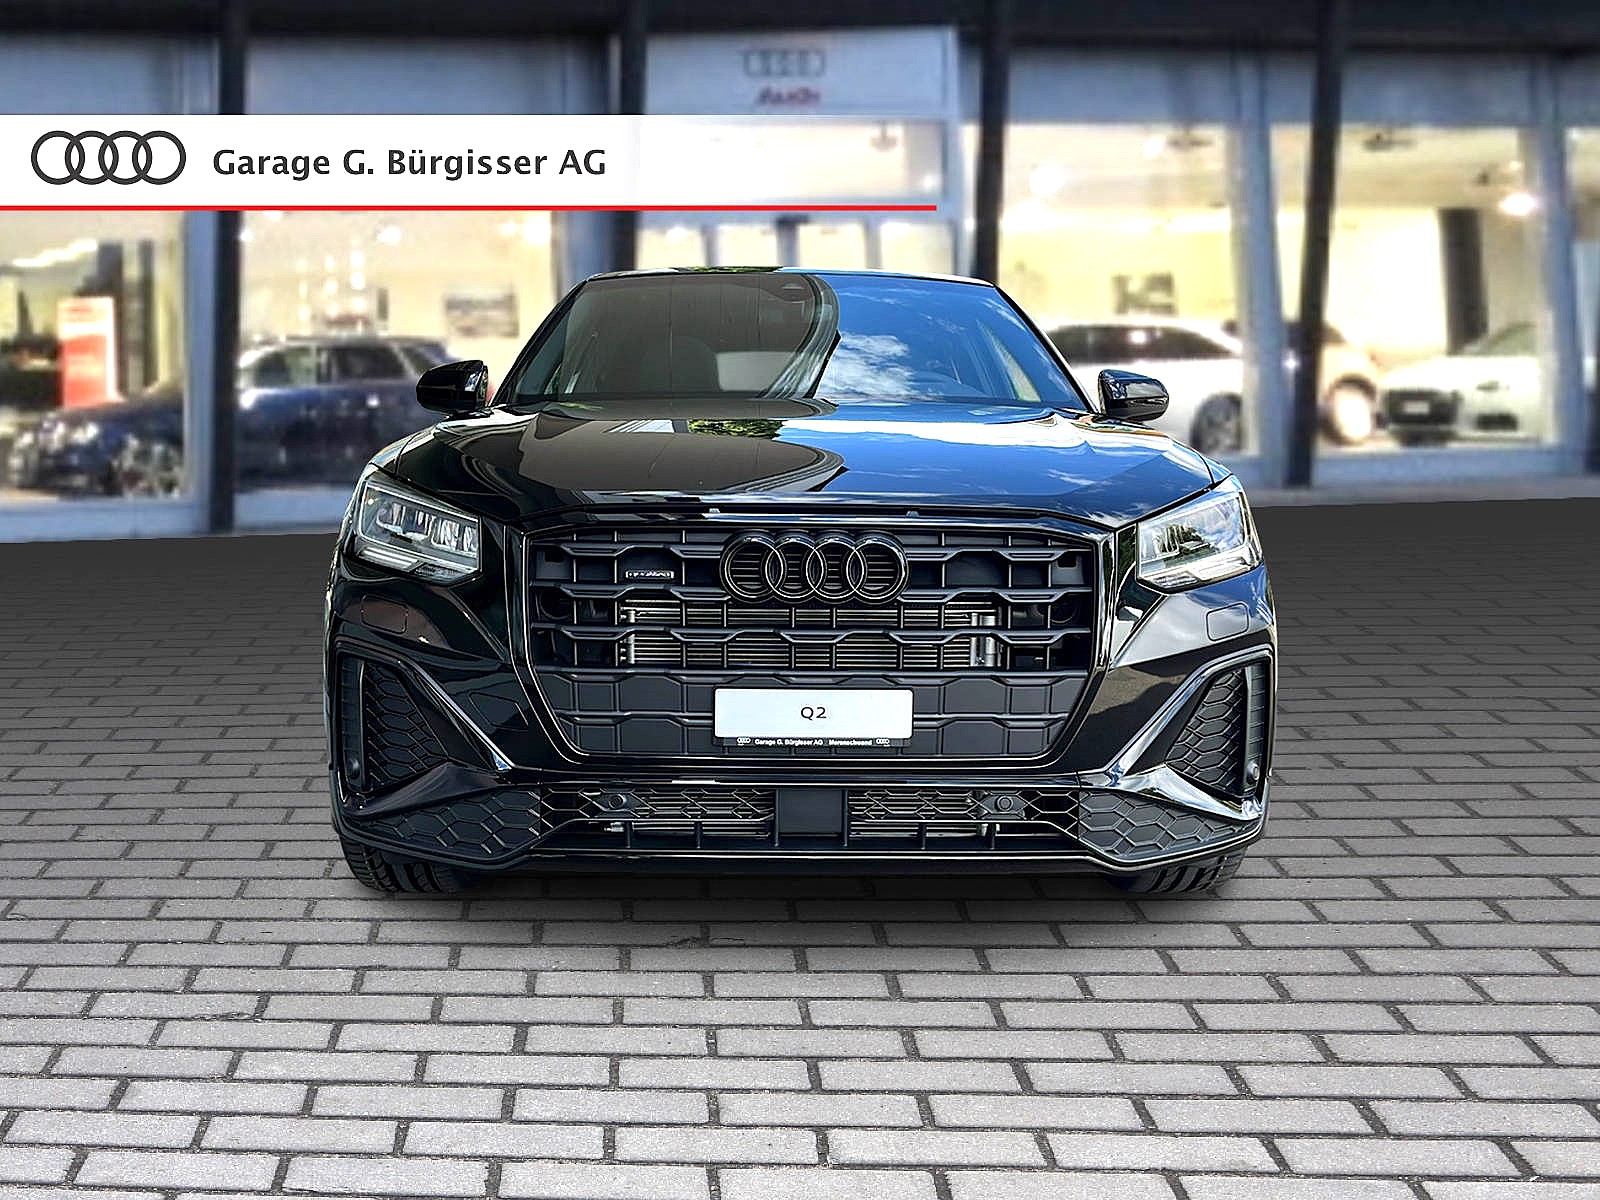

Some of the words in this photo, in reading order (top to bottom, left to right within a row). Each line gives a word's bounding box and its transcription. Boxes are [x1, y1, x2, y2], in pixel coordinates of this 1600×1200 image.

[800, 706, 828, 721] Q2
[754, 738, 776, 747] Garage
[813, 738, 824, 746] AG
